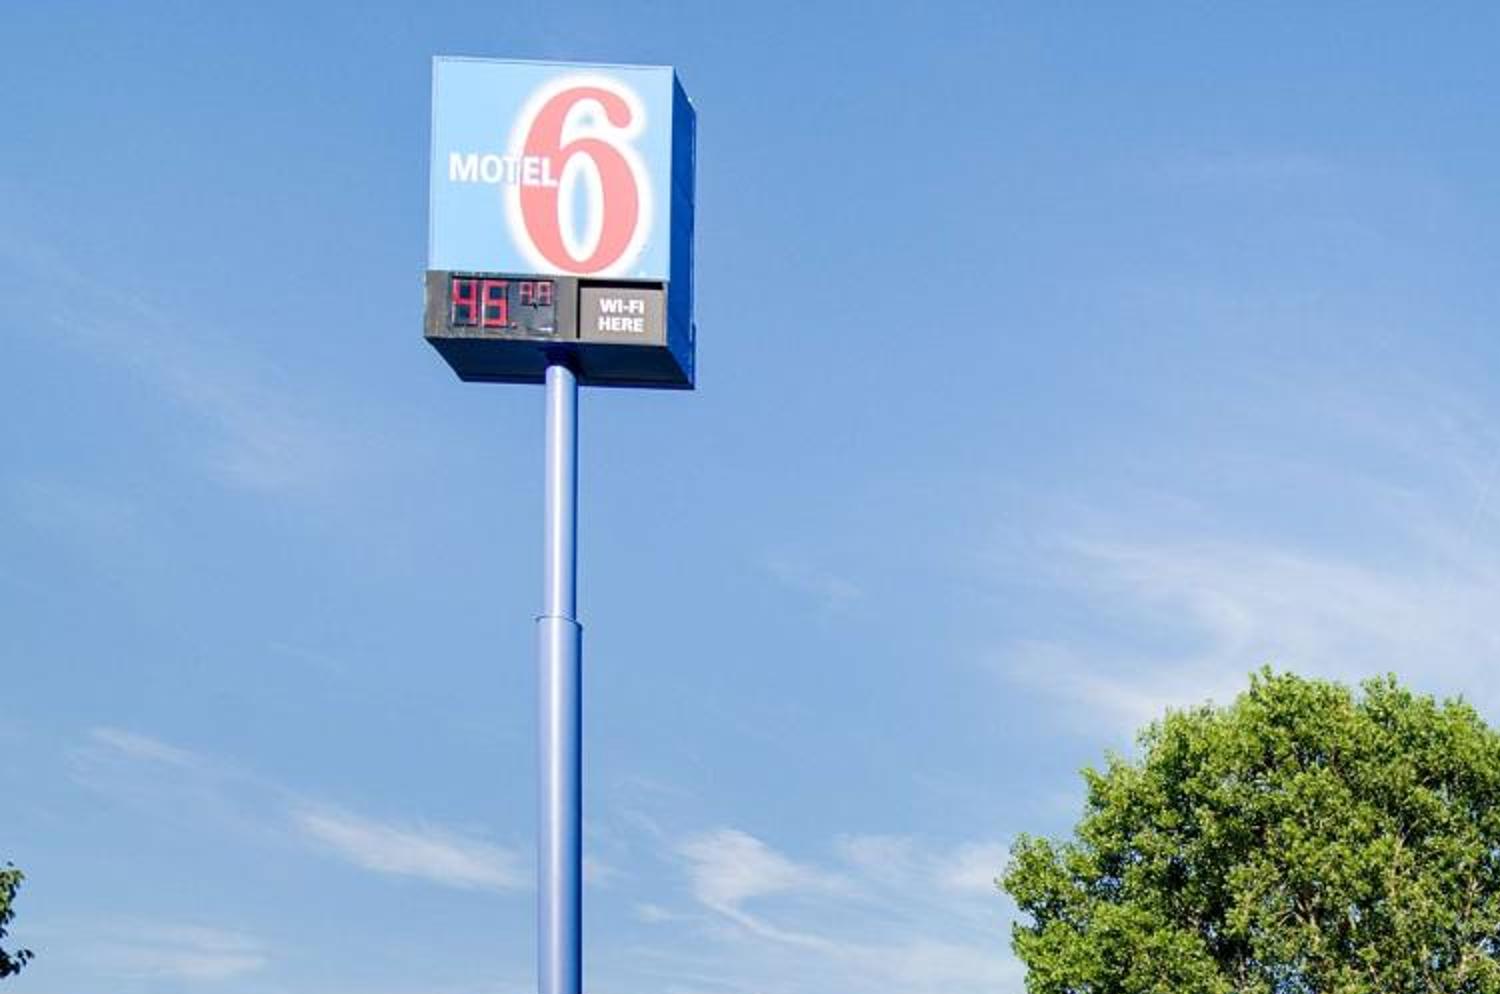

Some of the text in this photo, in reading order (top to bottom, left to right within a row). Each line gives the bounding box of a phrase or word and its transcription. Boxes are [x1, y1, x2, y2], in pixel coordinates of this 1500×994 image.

[449, 152, 558, 187] MOTEL
[519, 85, 640, 274] 6
[599, 298, 644, 315] WI-FI
[598, 316, 644, 332] HERE
